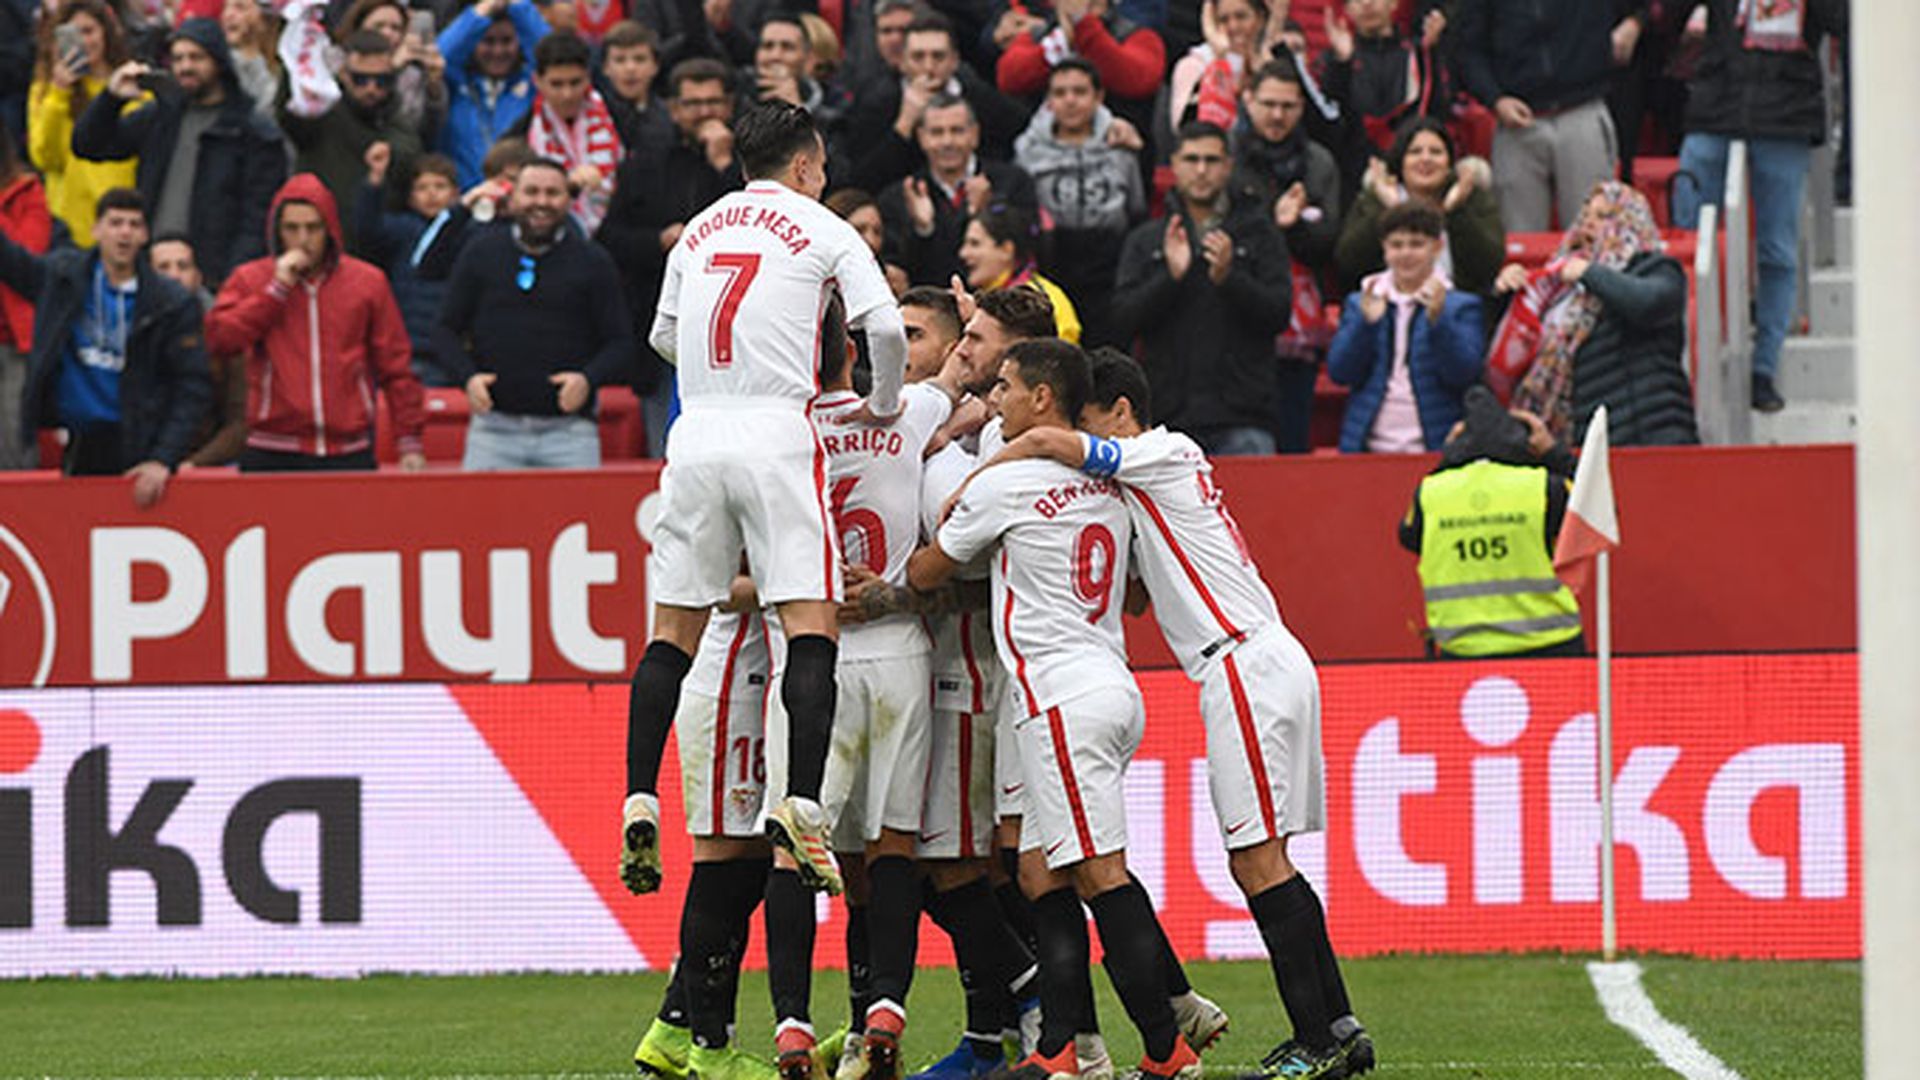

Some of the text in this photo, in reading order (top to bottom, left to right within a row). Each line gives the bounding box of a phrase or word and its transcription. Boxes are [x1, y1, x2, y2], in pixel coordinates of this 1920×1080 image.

[753, 208, 811, 256] MESA
[704, 253, 762, 370] 7
[1070, 523, 1116, 624] 9
[1453, 536, 1509, 561] 105
